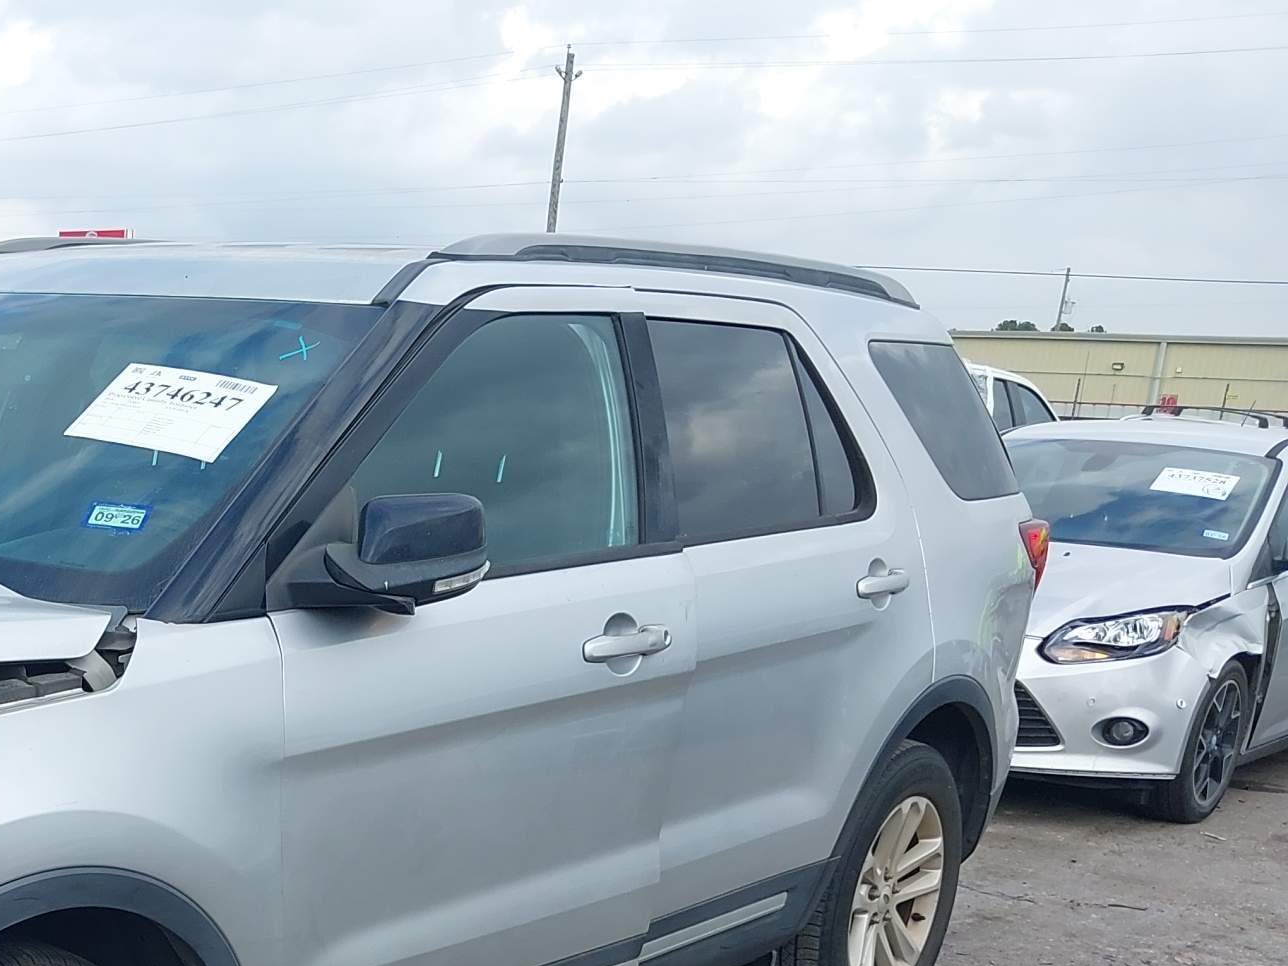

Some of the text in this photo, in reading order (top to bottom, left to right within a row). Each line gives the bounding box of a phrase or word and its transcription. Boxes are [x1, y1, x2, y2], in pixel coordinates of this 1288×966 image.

[123, 380, 245, 411] 43746247
[94, 511, 114, 523] 09
[120, 514, 142, 526] 26
